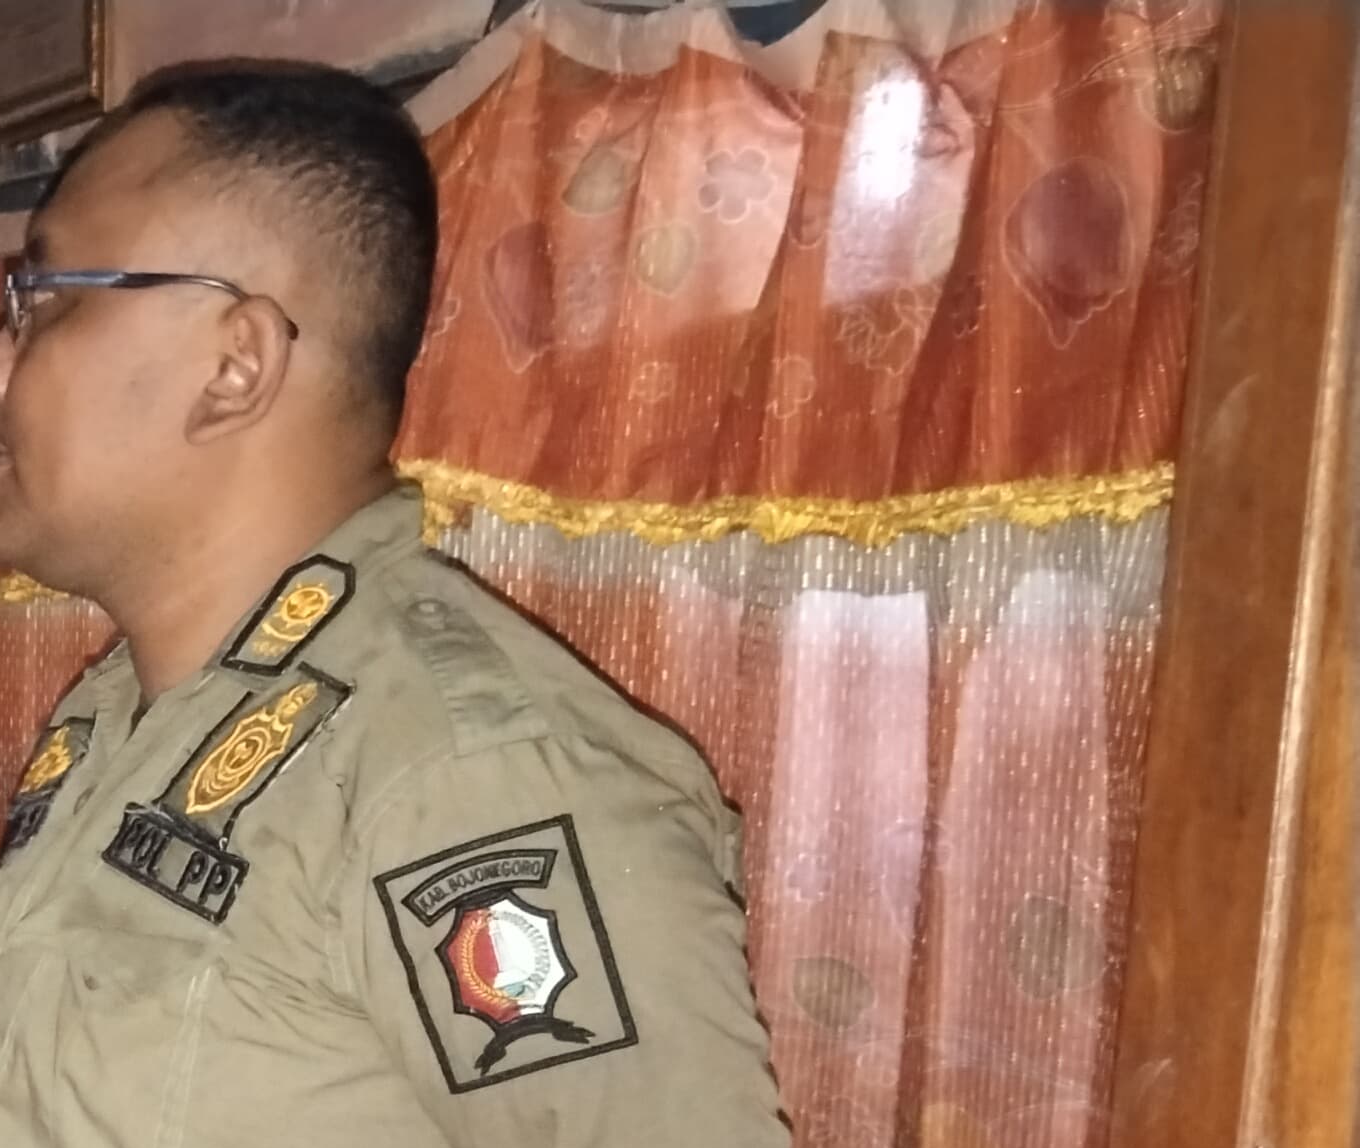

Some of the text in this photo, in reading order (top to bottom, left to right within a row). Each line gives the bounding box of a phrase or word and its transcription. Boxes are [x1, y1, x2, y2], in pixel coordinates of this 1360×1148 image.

[115, 817, 172, 879] POL
[175, 850, 232, 905] PP
[447, 859, 541, 892] BOJONEGORO
